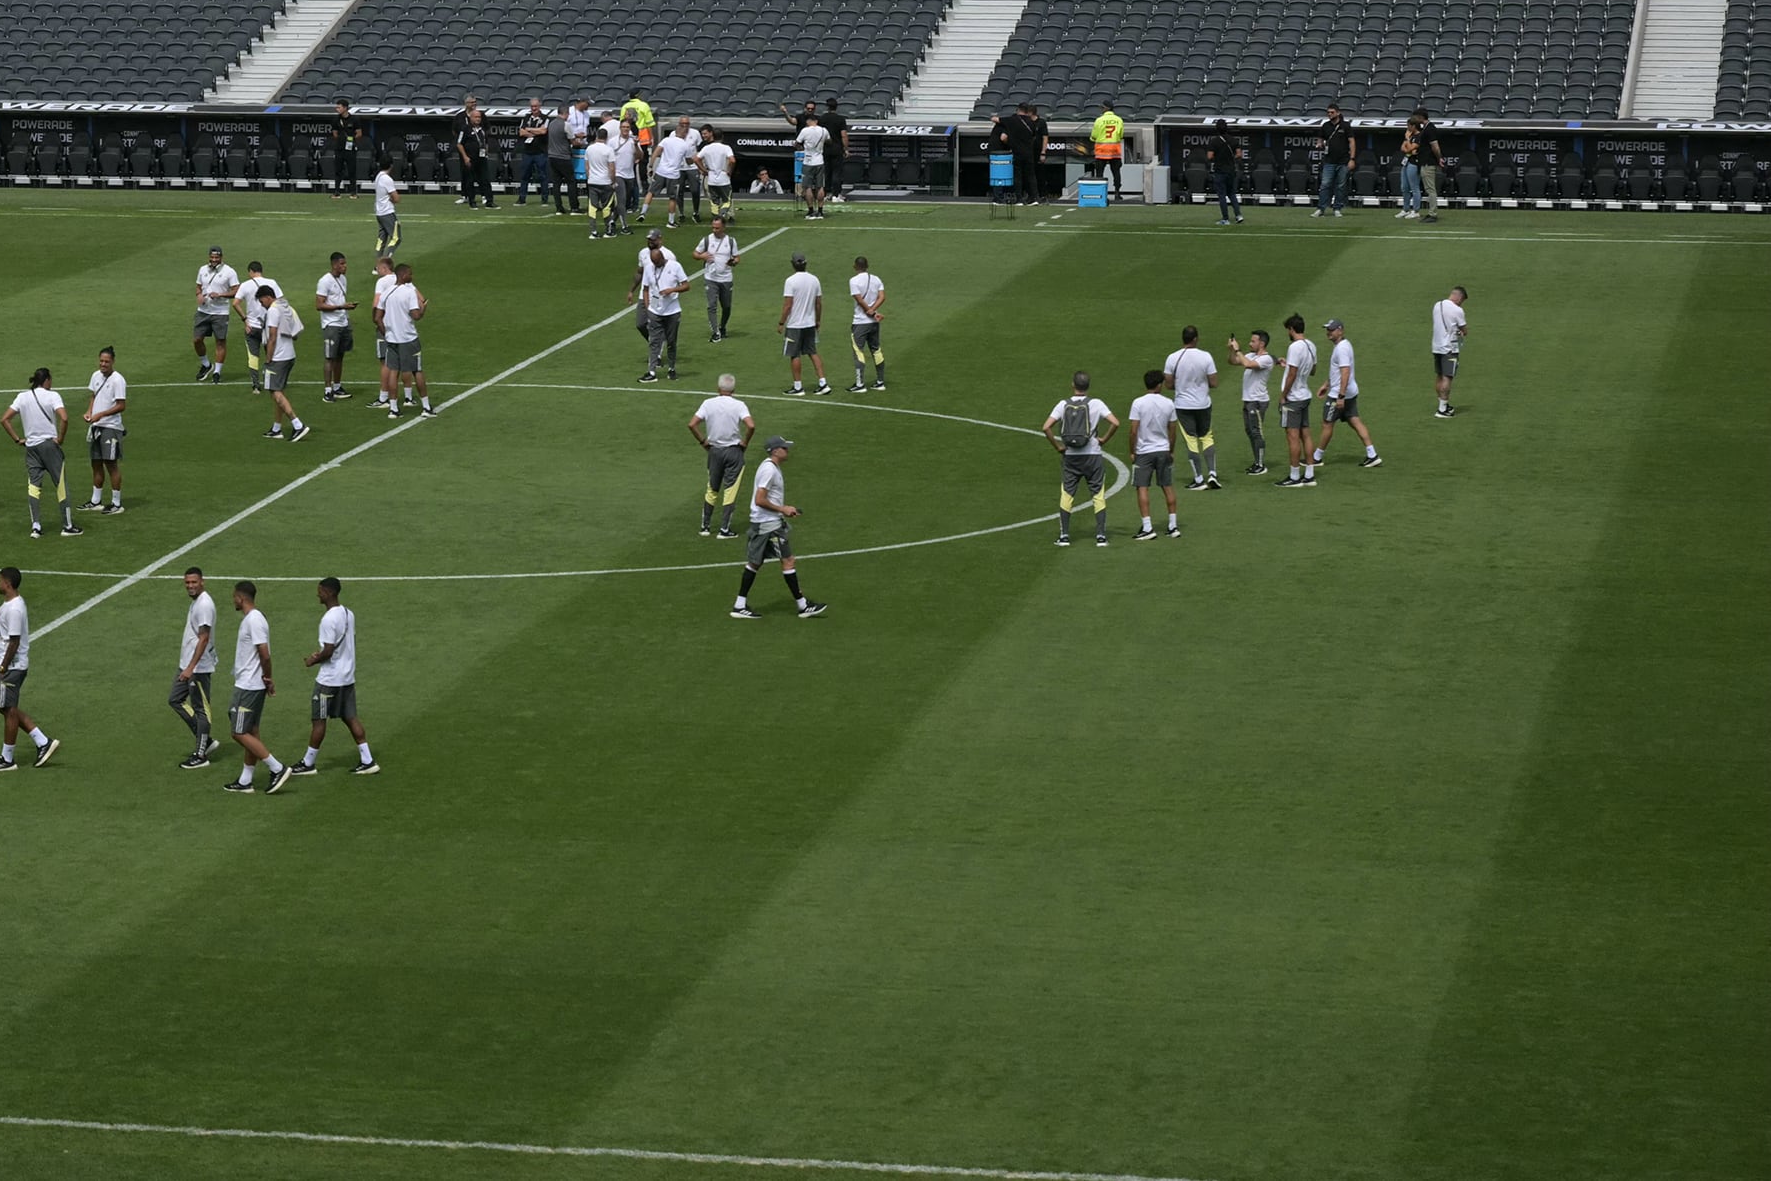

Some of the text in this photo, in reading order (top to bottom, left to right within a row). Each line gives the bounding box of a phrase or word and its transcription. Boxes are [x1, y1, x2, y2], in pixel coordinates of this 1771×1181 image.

[12, 120, 74, 130] POWERADE
[199, 122, 260, 132] POWERADE
[1489, 139, 1557, 150] POWERADE
[1597, 141, 1666, 152] POWERADE
